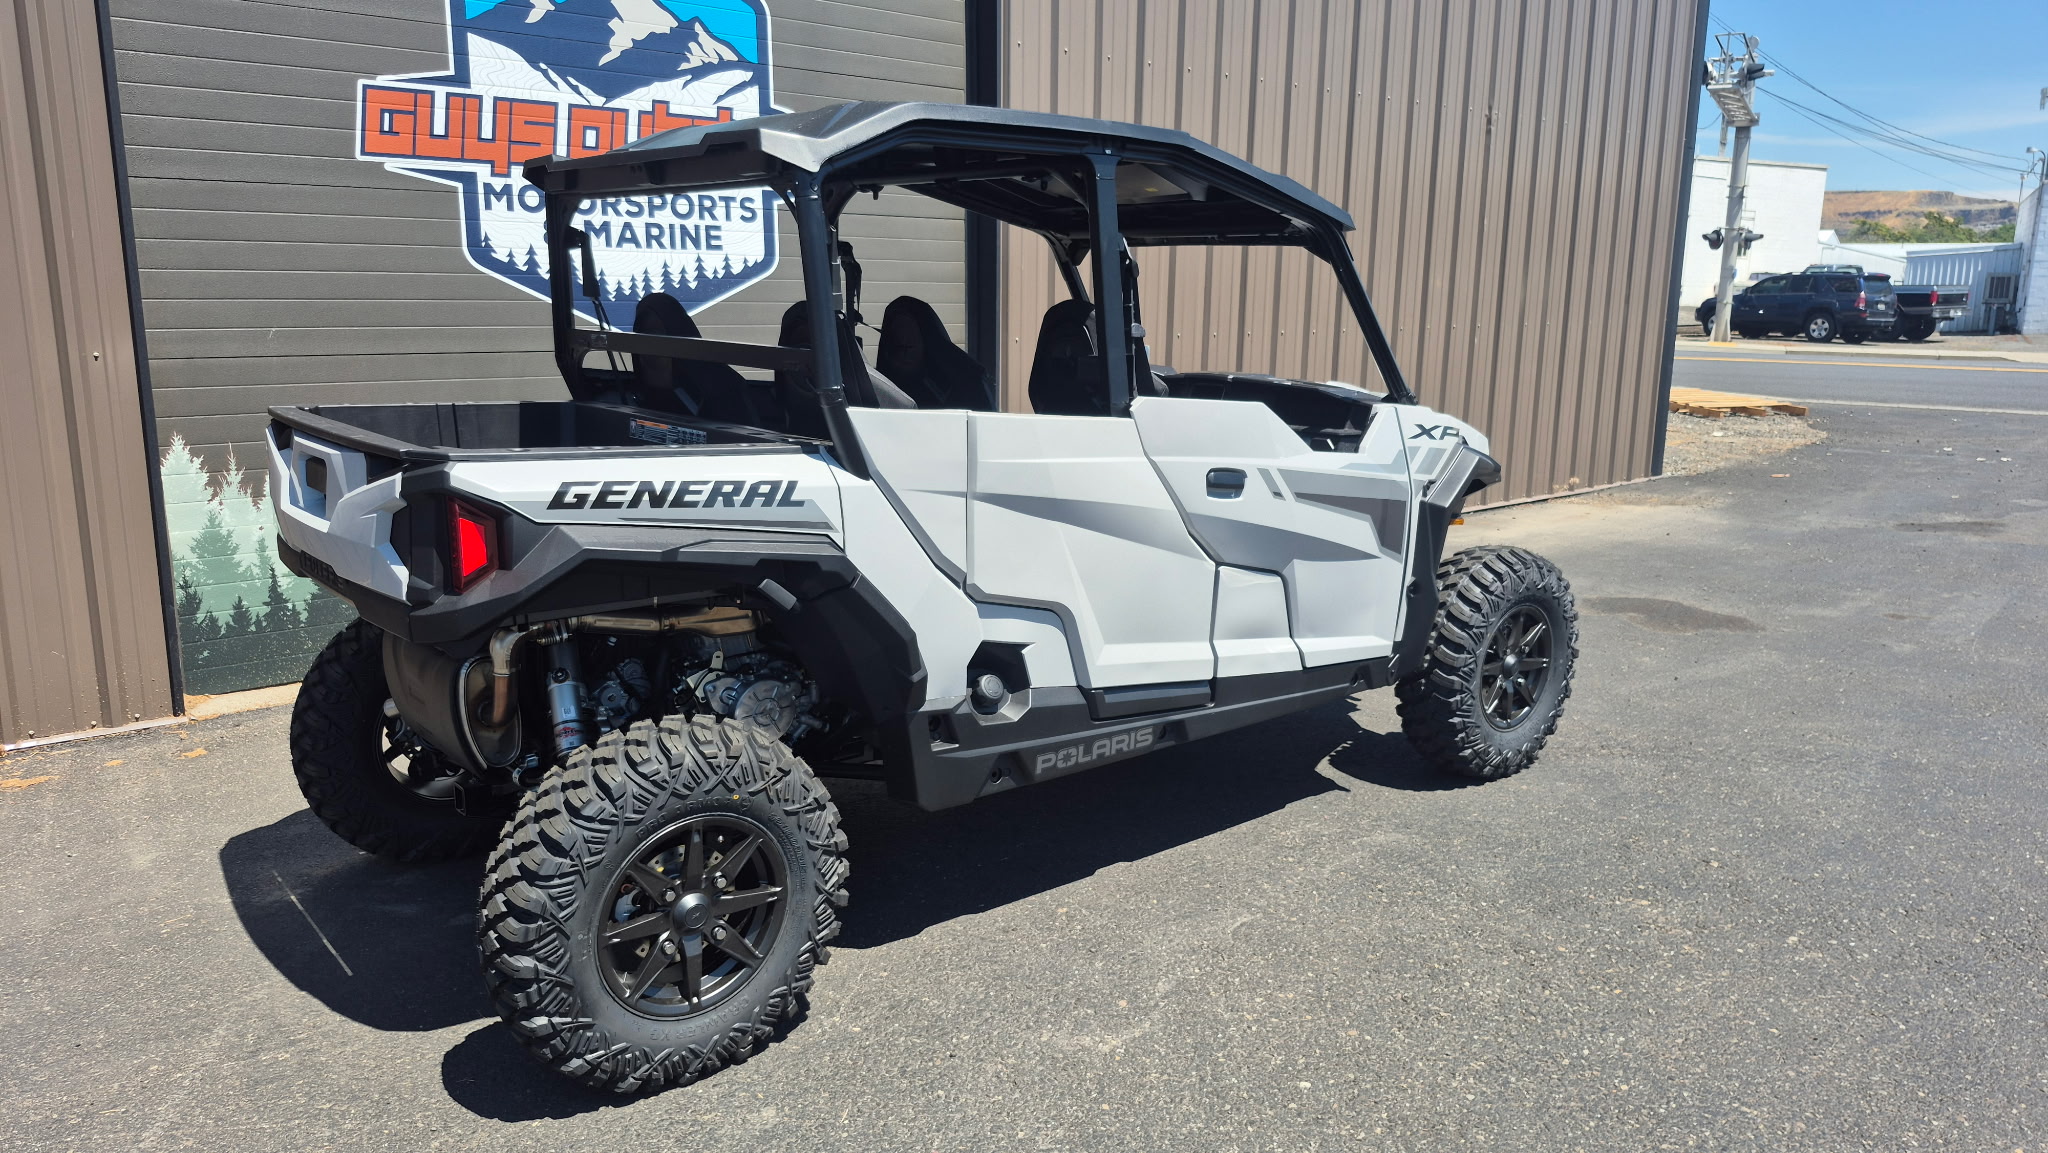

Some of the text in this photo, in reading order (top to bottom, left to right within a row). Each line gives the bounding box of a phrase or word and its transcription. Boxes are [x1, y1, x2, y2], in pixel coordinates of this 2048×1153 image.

[483, 181, 758, 224] MOORSPORTS
[584, 219, 723, 251] MARINE
[1408, 423, 1460, 441] XP
[546, 480, 806, 510] GENERAL
[1035, 727, 1154, 775] POLARIS
